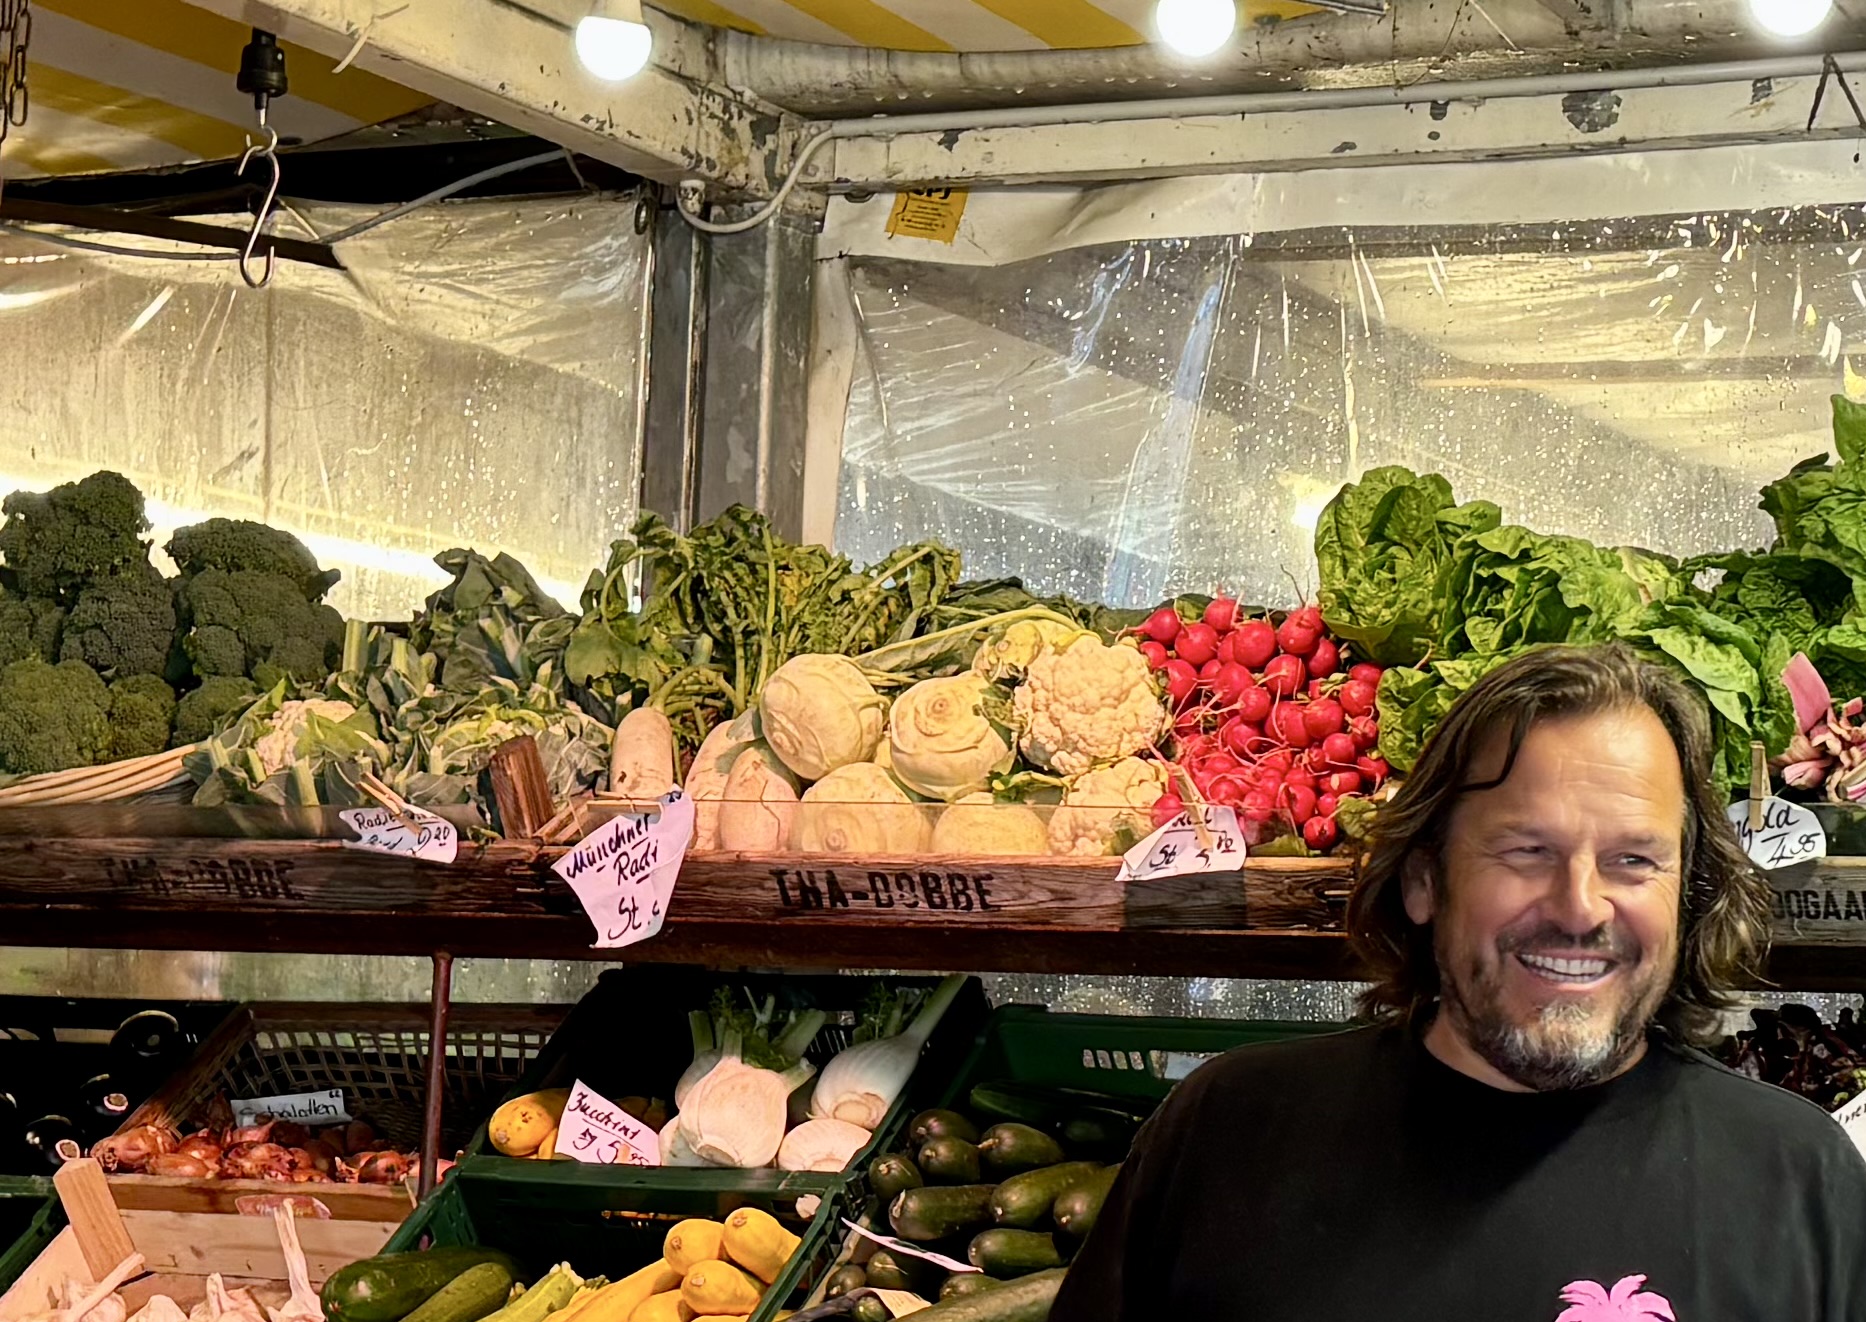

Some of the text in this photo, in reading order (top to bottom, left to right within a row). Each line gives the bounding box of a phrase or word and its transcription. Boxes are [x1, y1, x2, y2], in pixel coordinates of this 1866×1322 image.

[567, 813, 650, 879] Münchner
[613, 839, 659, 886] Radi
[568, 1091, 641, 1140] Zucchini
